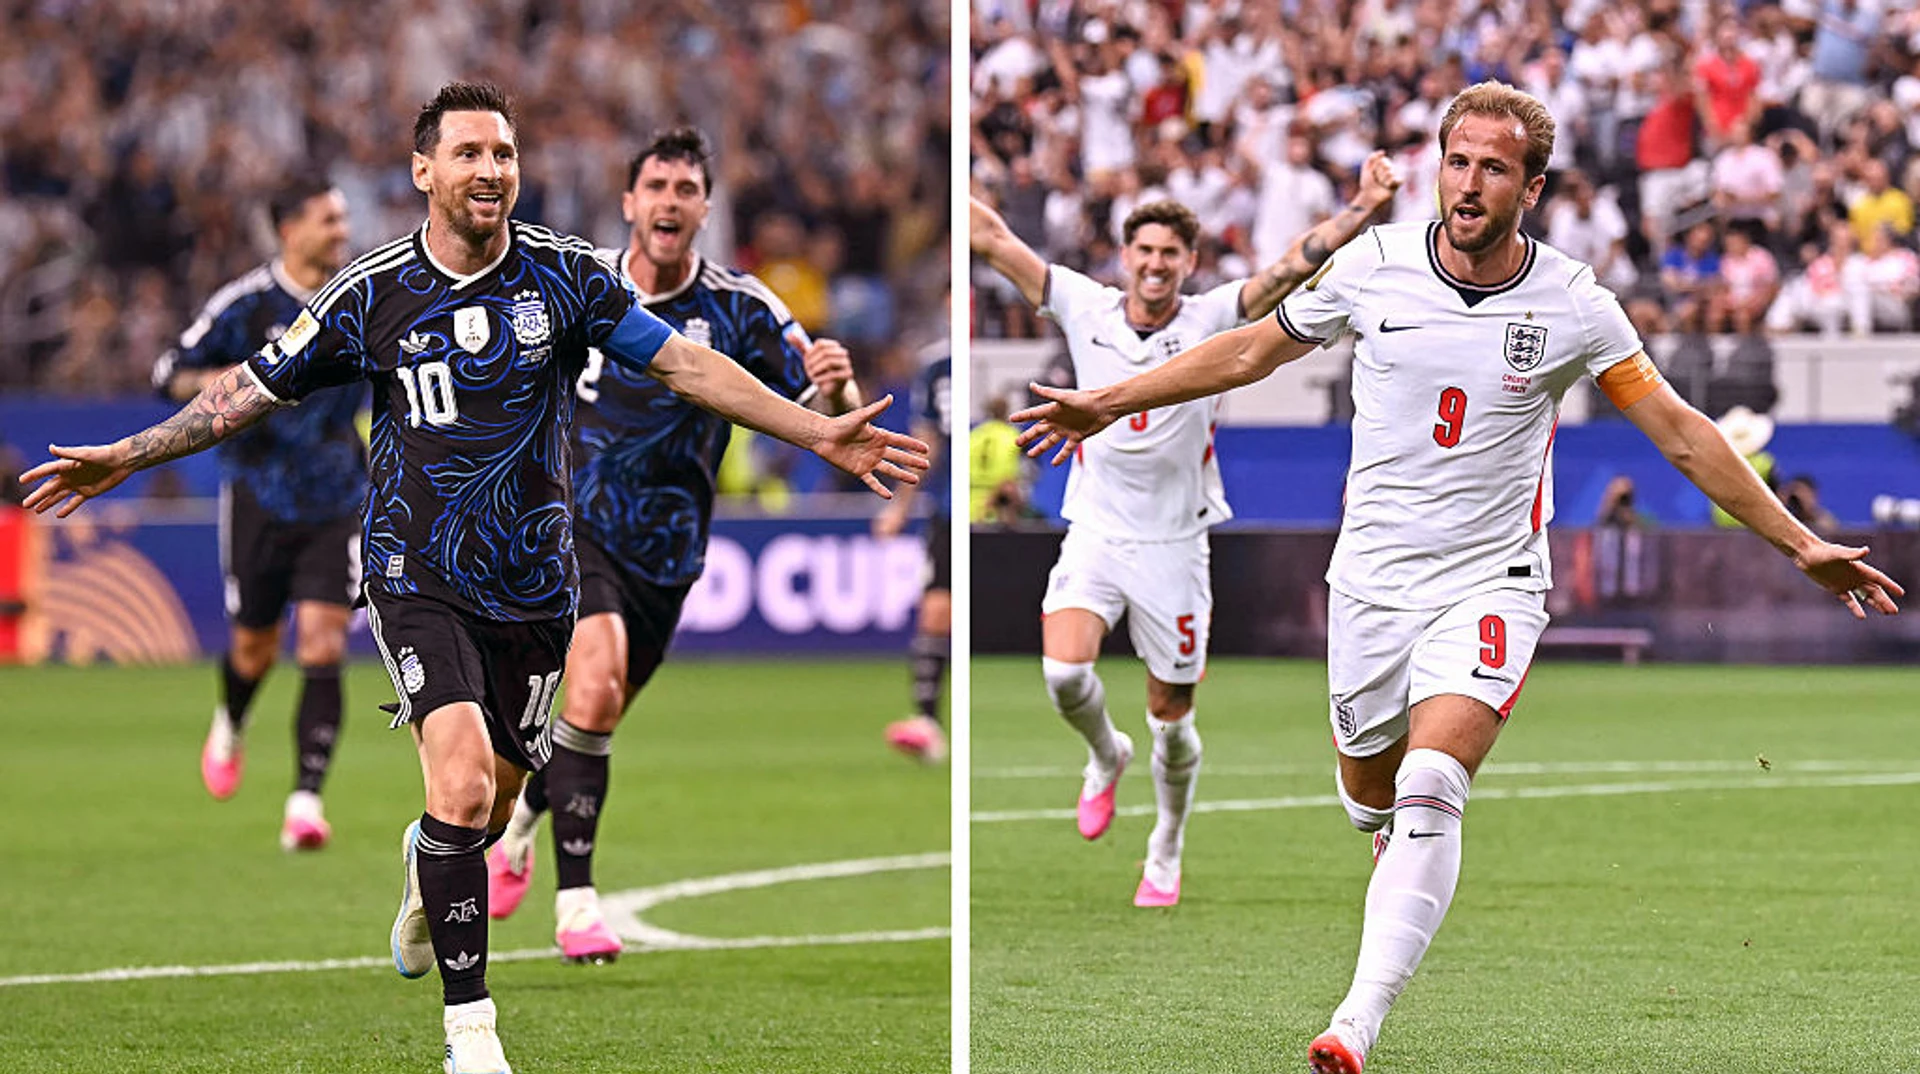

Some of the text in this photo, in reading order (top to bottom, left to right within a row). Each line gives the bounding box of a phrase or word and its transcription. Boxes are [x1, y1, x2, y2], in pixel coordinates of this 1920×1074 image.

[396, 361, 458, 428] 10
[1433, 386, 1467, 449] 9
[756, 533, 930, 634] CUP
[1176, 613, 1196, 656] 5
[1478, 613, 1506, 669] 9
